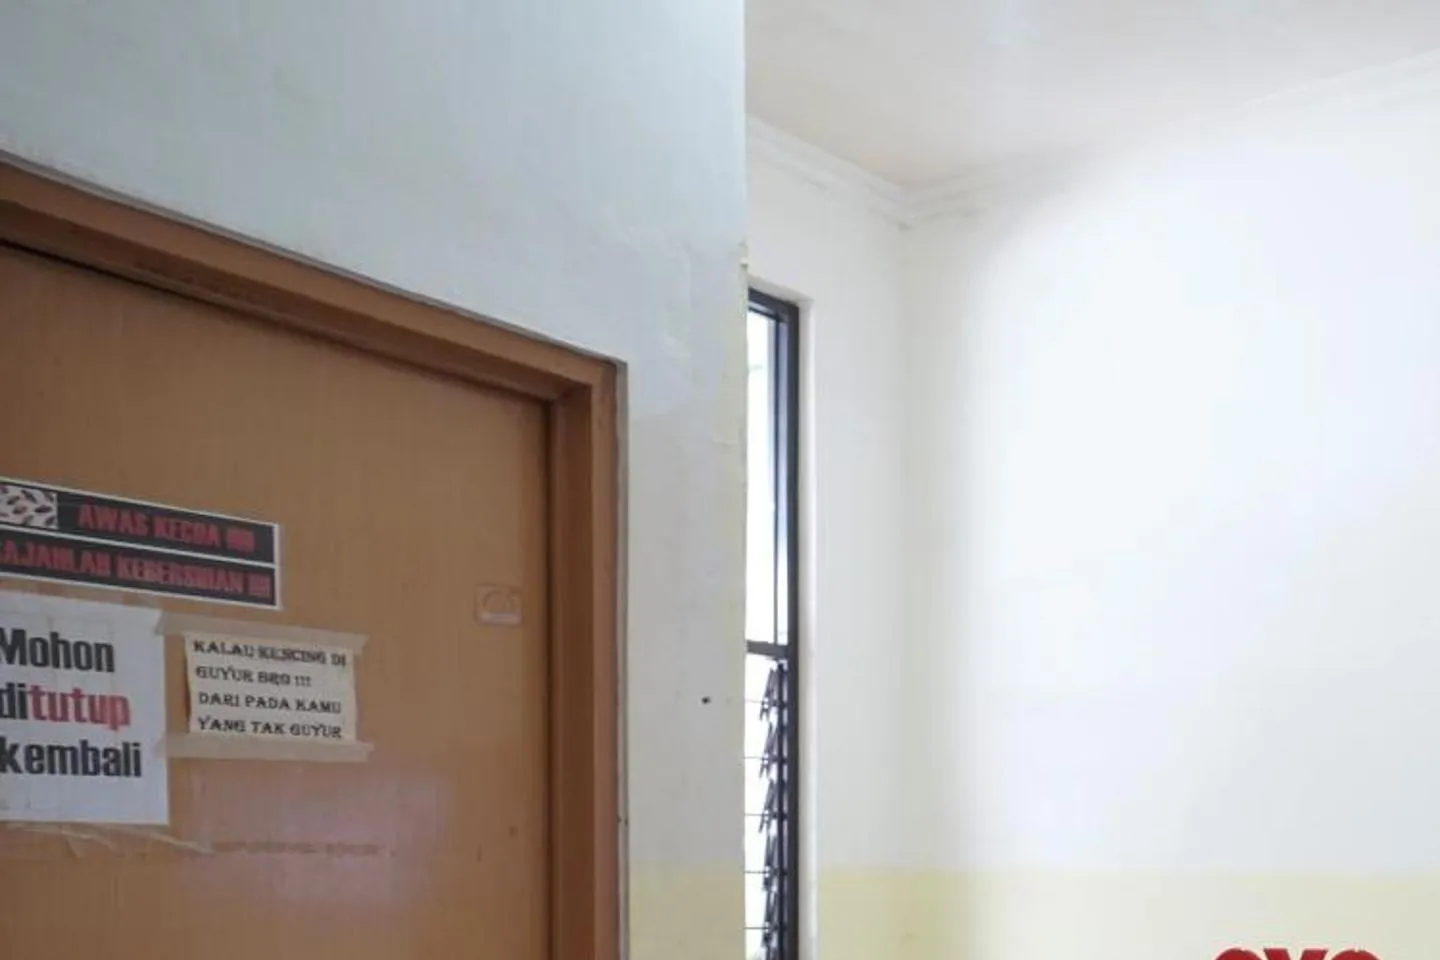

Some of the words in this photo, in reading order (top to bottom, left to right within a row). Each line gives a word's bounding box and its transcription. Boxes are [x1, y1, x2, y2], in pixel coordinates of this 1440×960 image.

[77, 503, 148, 536] AWAS
[0, 627, 115, 672] Mohon
[193, 640, 255, 659] KALAU
[0, 682, 131, 731] ditutup
[198, 691, 240, 708] DARI
[244, 694, 291, 710] PADA
[295, 700, 342, 715] KAMU
[197, 715, 246, 733] YANG
[250, 721, 286, 736] TAK
[289, 724, 343, 740] GUYUR
[0, 736, 141, 778] kembali
